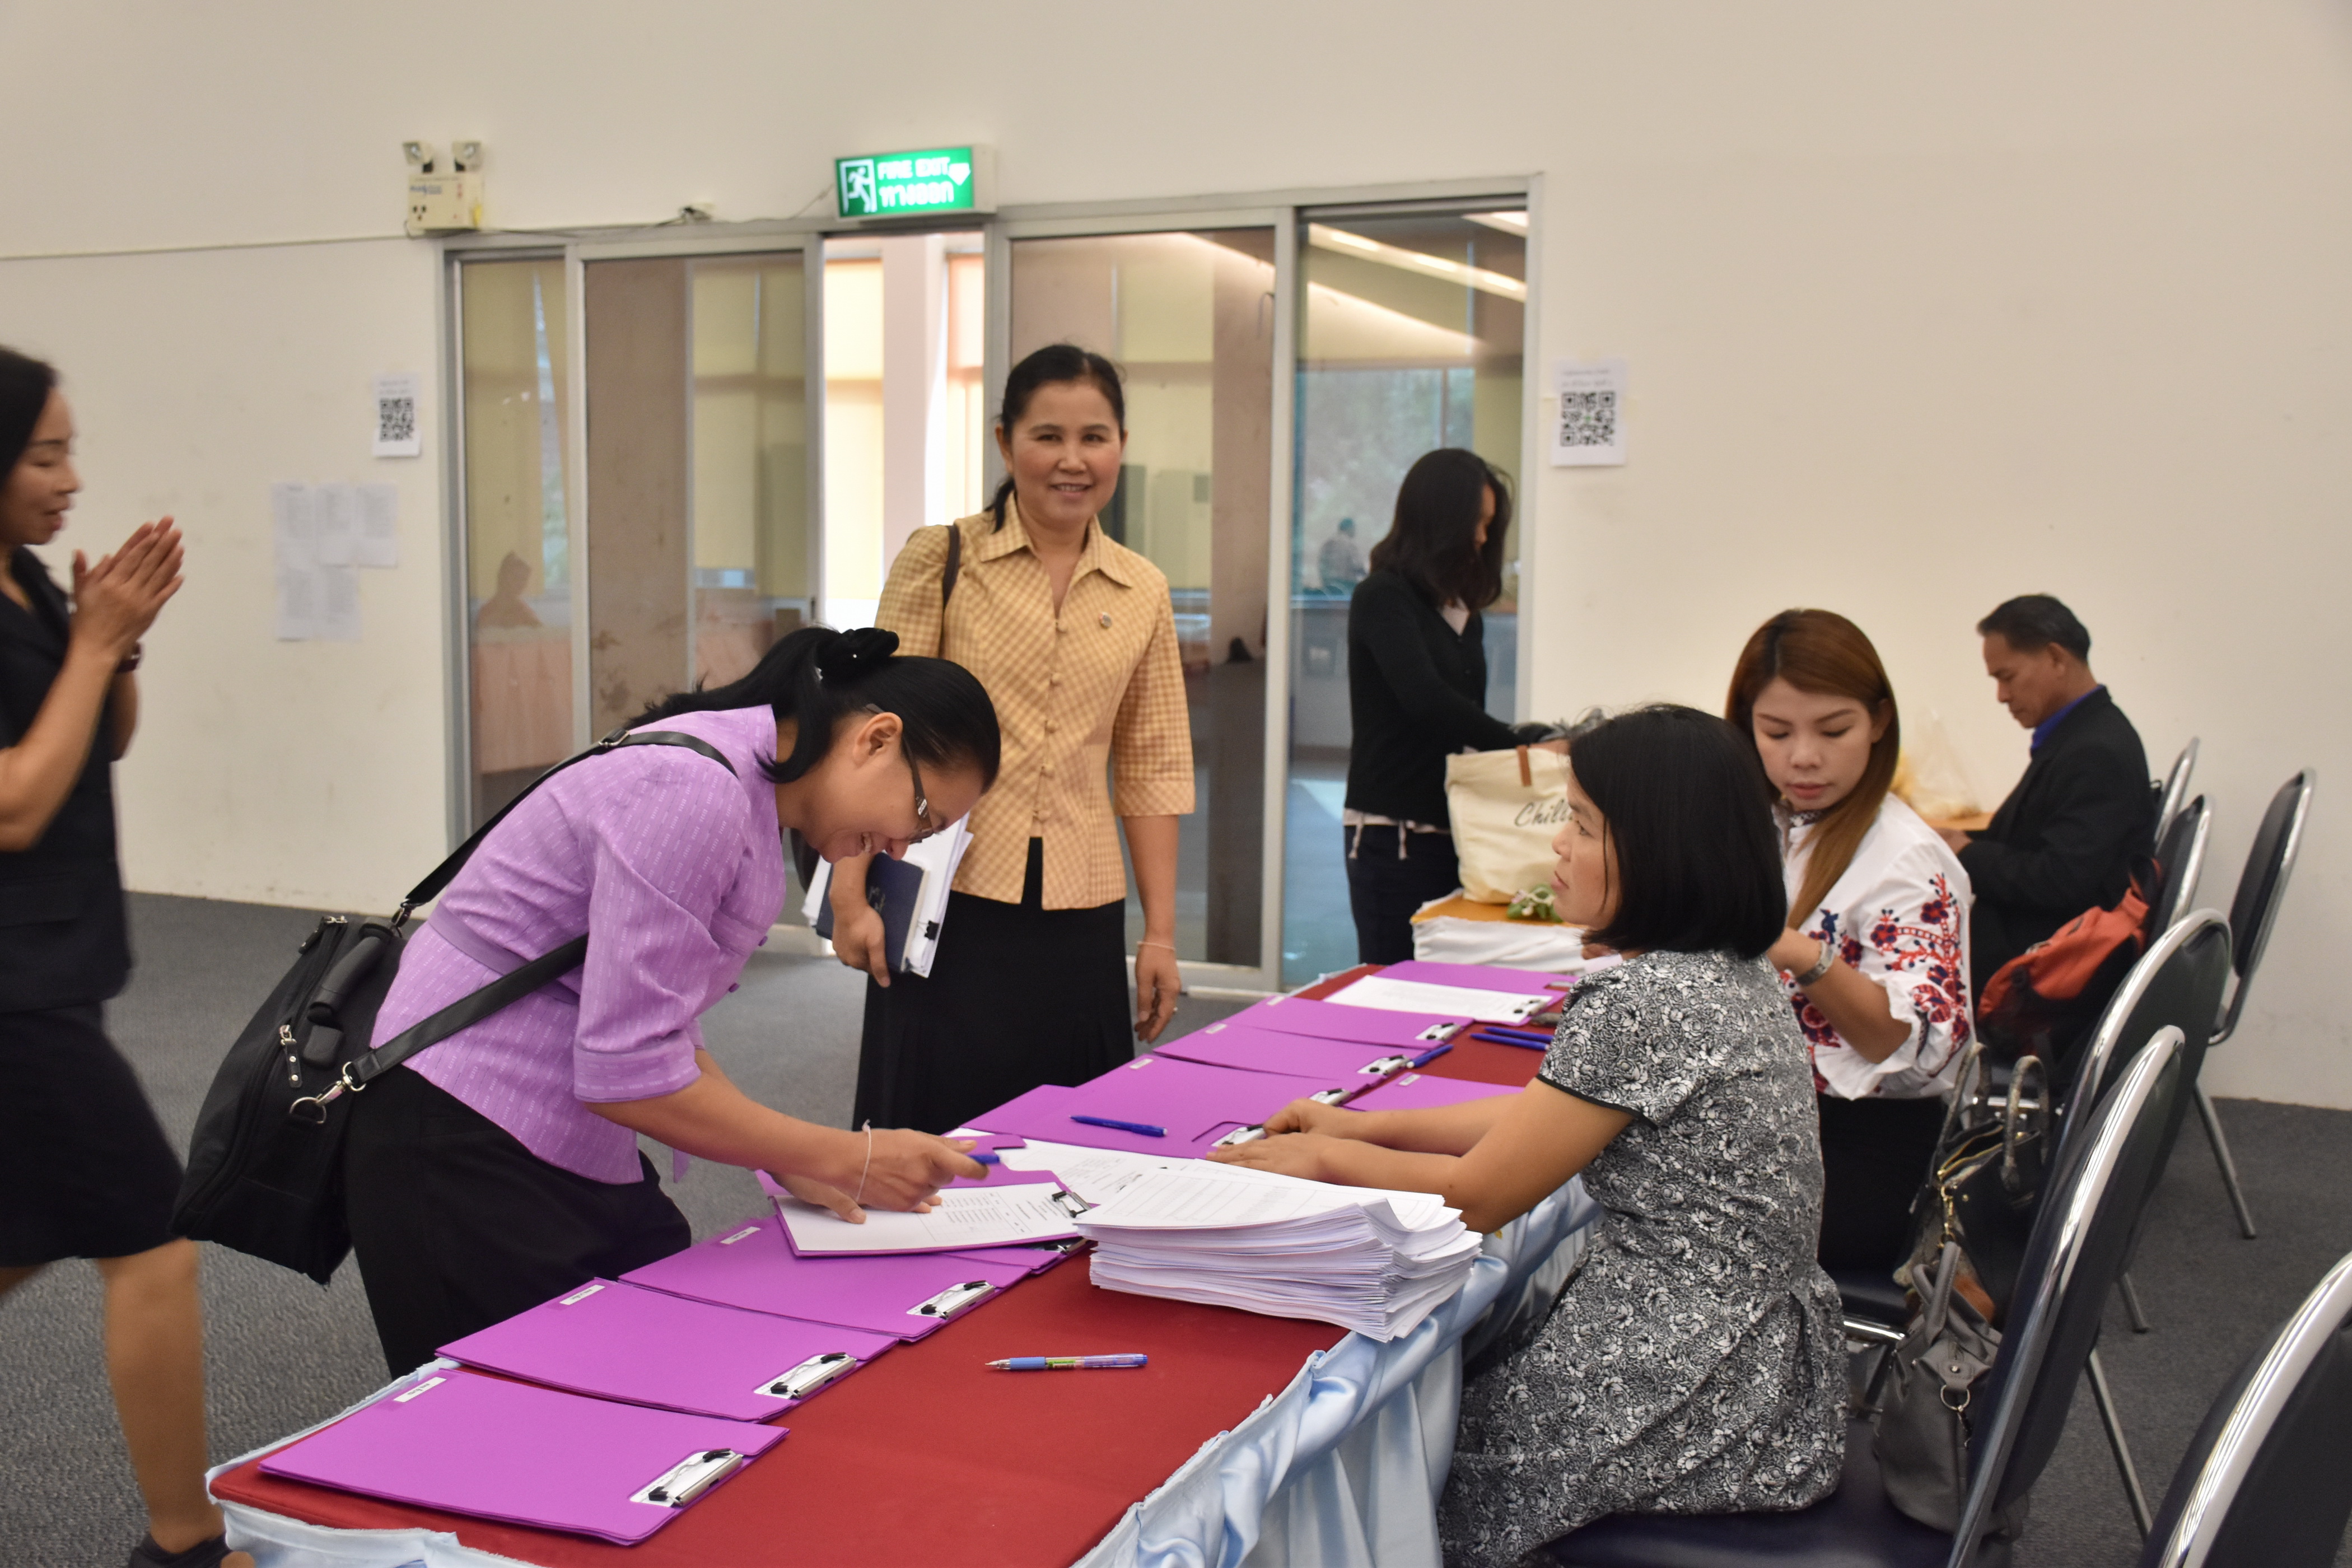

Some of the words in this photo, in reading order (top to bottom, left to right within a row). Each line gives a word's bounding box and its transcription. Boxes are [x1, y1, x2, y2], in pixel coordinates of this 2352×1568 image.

[878, 161, 912, 180] FIRE
[916, 157, 950, 176] EXIT
[879, 181, 954, 207] ทางออก
